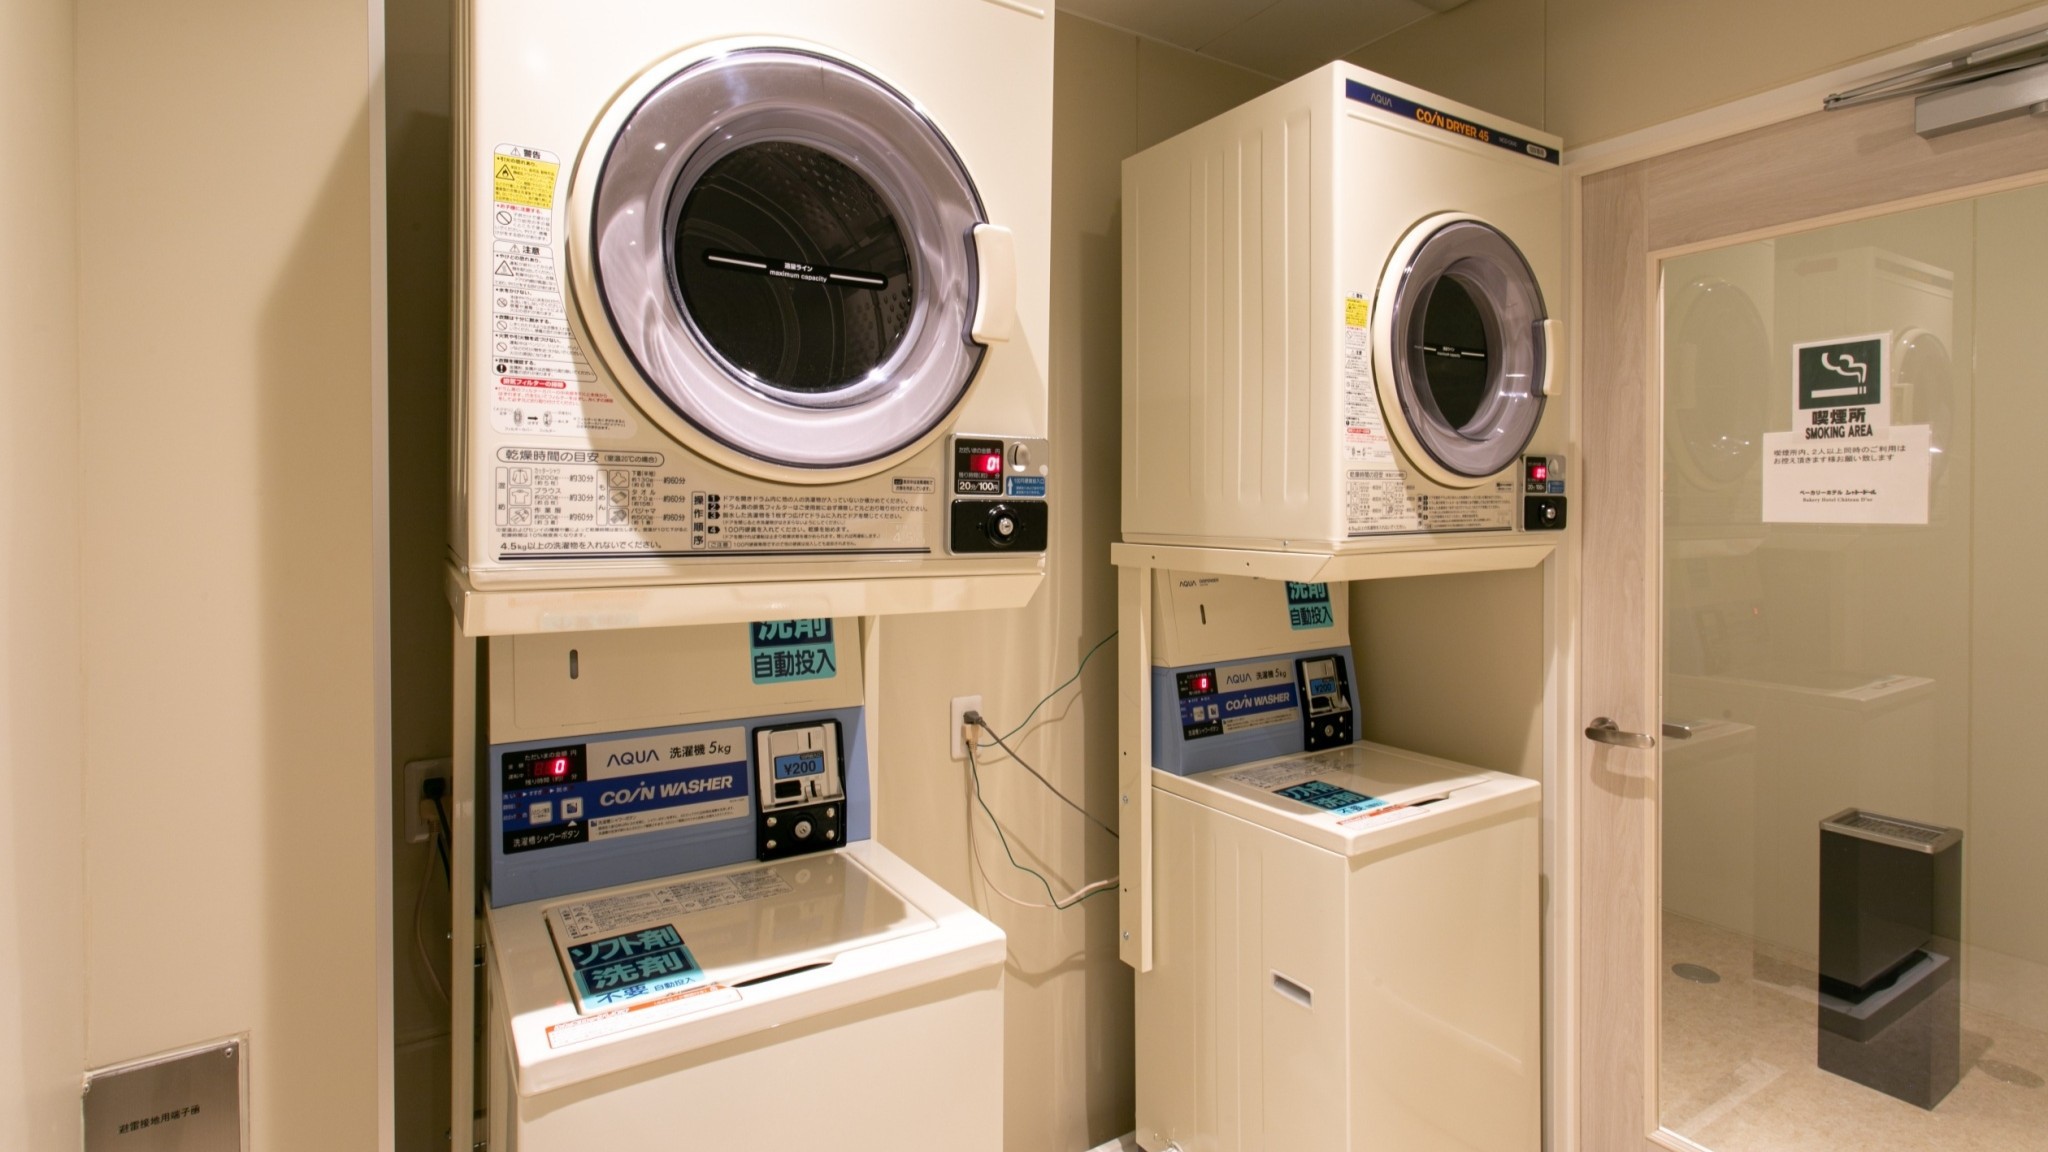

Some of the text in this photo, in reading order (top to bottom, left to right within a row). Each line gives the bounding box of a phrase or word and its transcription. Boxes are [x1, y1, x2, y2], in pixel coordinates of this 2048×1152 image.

[1371, 92, 1393, 108] AQUA
[1446, 119, 1478, 138] DRYER
[1478, 129, 1489, 143] 45
[522, 245, 540, 256] 注意
[769, 270, 828, 284] maximum capacity
[1812, 407, 1866, 426] 喫煙所
[1806, 424, 1873, 440] SMOKING AREA
[505, 449, 600, 464] 乾燥時間の目安
[569, 474, 594, 483] 約30分
[569, 494, 594, 502] 約30分
[569, 512, 594, 521] 約60分
[693, 495, 704, 546] 操作順序
[1290, 606, 1333, 626] 自動投入
[754, 648, 836, 678] 自動投入
[1226, 672, 1252, 684] AQUA
[1314, 684, 1332, 693] ¥200
[1226, 694, 1253, 711] COIN
[1254, 692, 1290, 706] WASHER
[606, 740, 732, 768] AQUA 洗濯機 5kg
[554, 759, 566, 774] 0
[784, 760, 816, 776] ¥200
[600, 775, 733, 807] COIN WASHER
[513, 830, 580, 848] 洗濯槽シャワーボタン
[571, 926, 682, 966] ソフト剤
[590, 950, 685, 988] 洗剤
[596, 976, 697, 1004] 不要 自動投入
